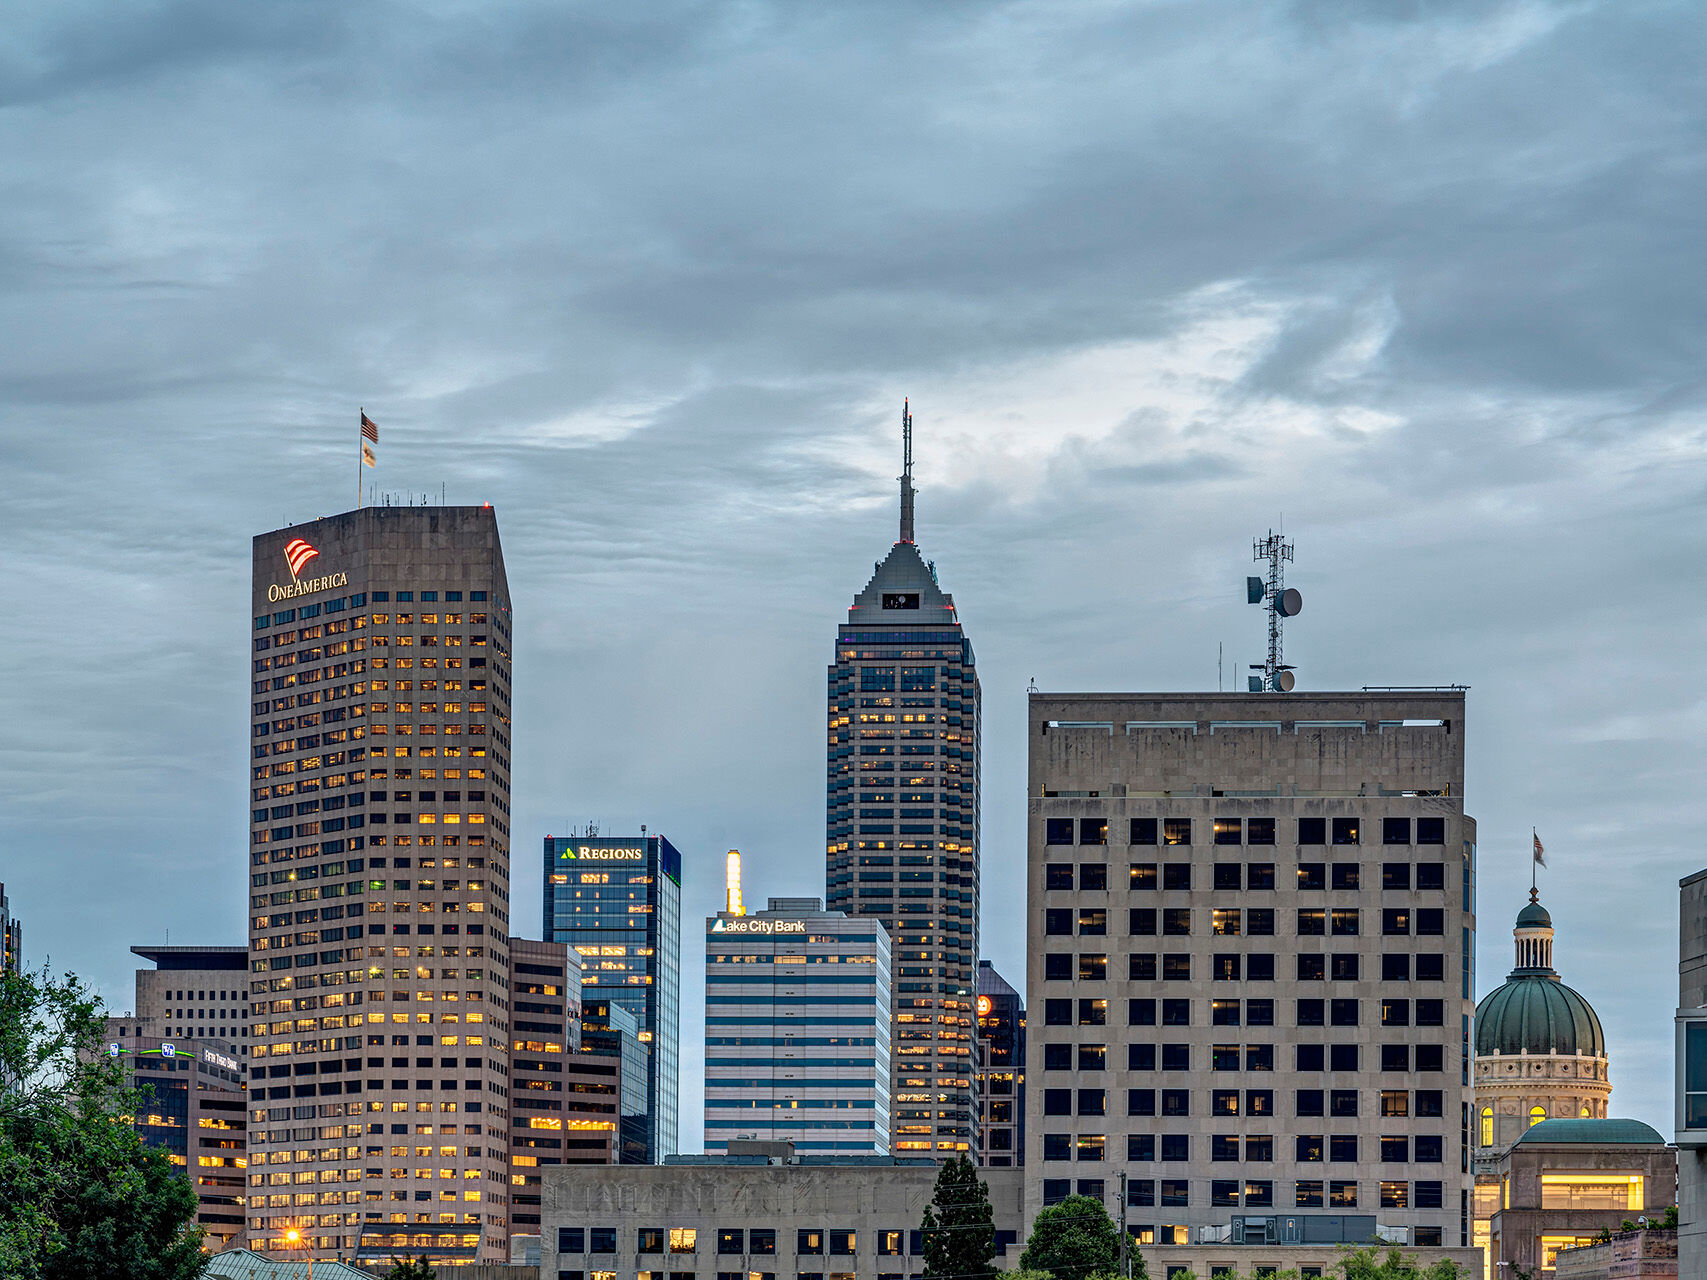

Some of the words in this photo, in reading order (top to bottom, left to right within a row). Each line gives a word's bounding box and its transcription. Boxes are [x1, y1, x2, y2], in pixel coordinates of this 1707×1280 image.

[579, 846, 642, 860] REGIONS
[710, 919, 748, 932] Lake
[749, 920, 774, 935] City
[775, 920, 806, 932] Bank
